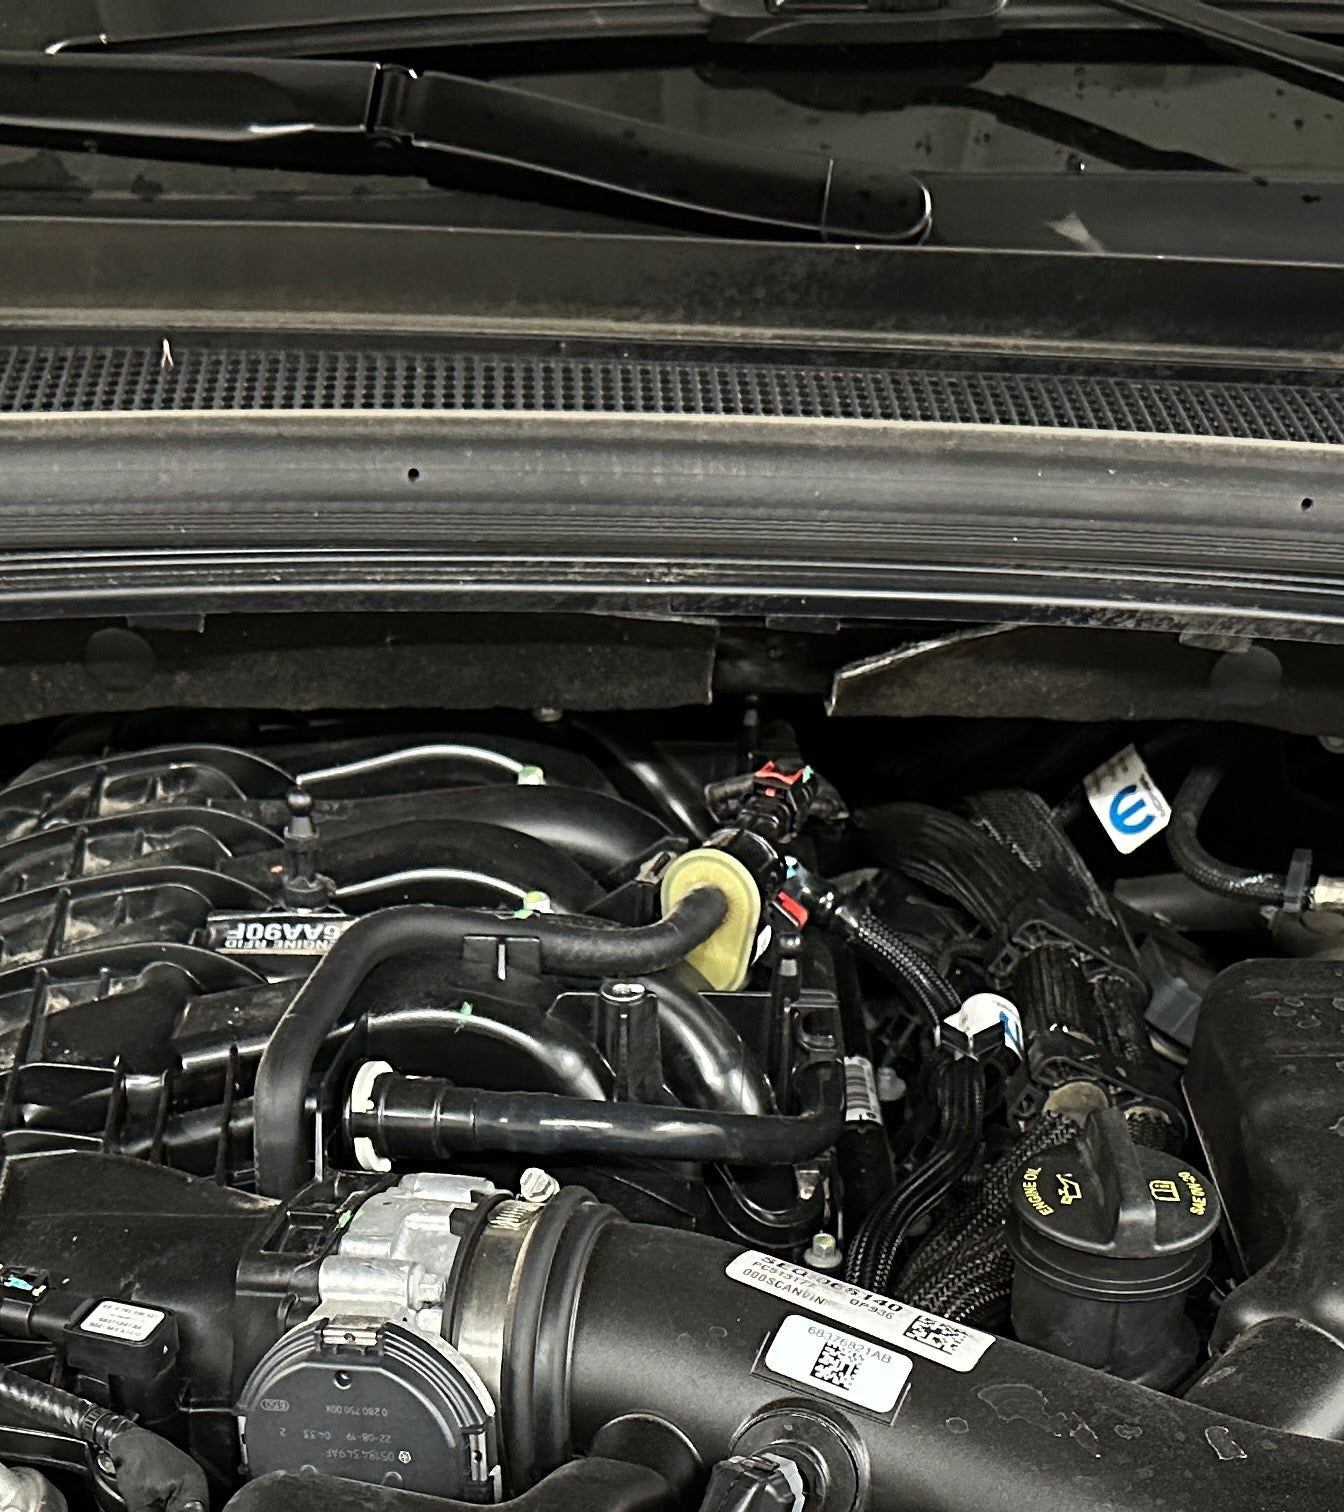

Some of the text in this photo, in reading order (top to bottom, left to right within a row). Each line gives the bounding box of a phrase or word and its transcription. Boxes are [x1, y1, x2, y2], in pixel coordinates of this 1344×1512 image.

[226, 922, 340, 940] 6AA90F
[274, 940, 334, 949] NGINE
[1022, 1167, 1054, 1216] ENGINE OIL
[1190, 1195, 1207, 1216] SAE
